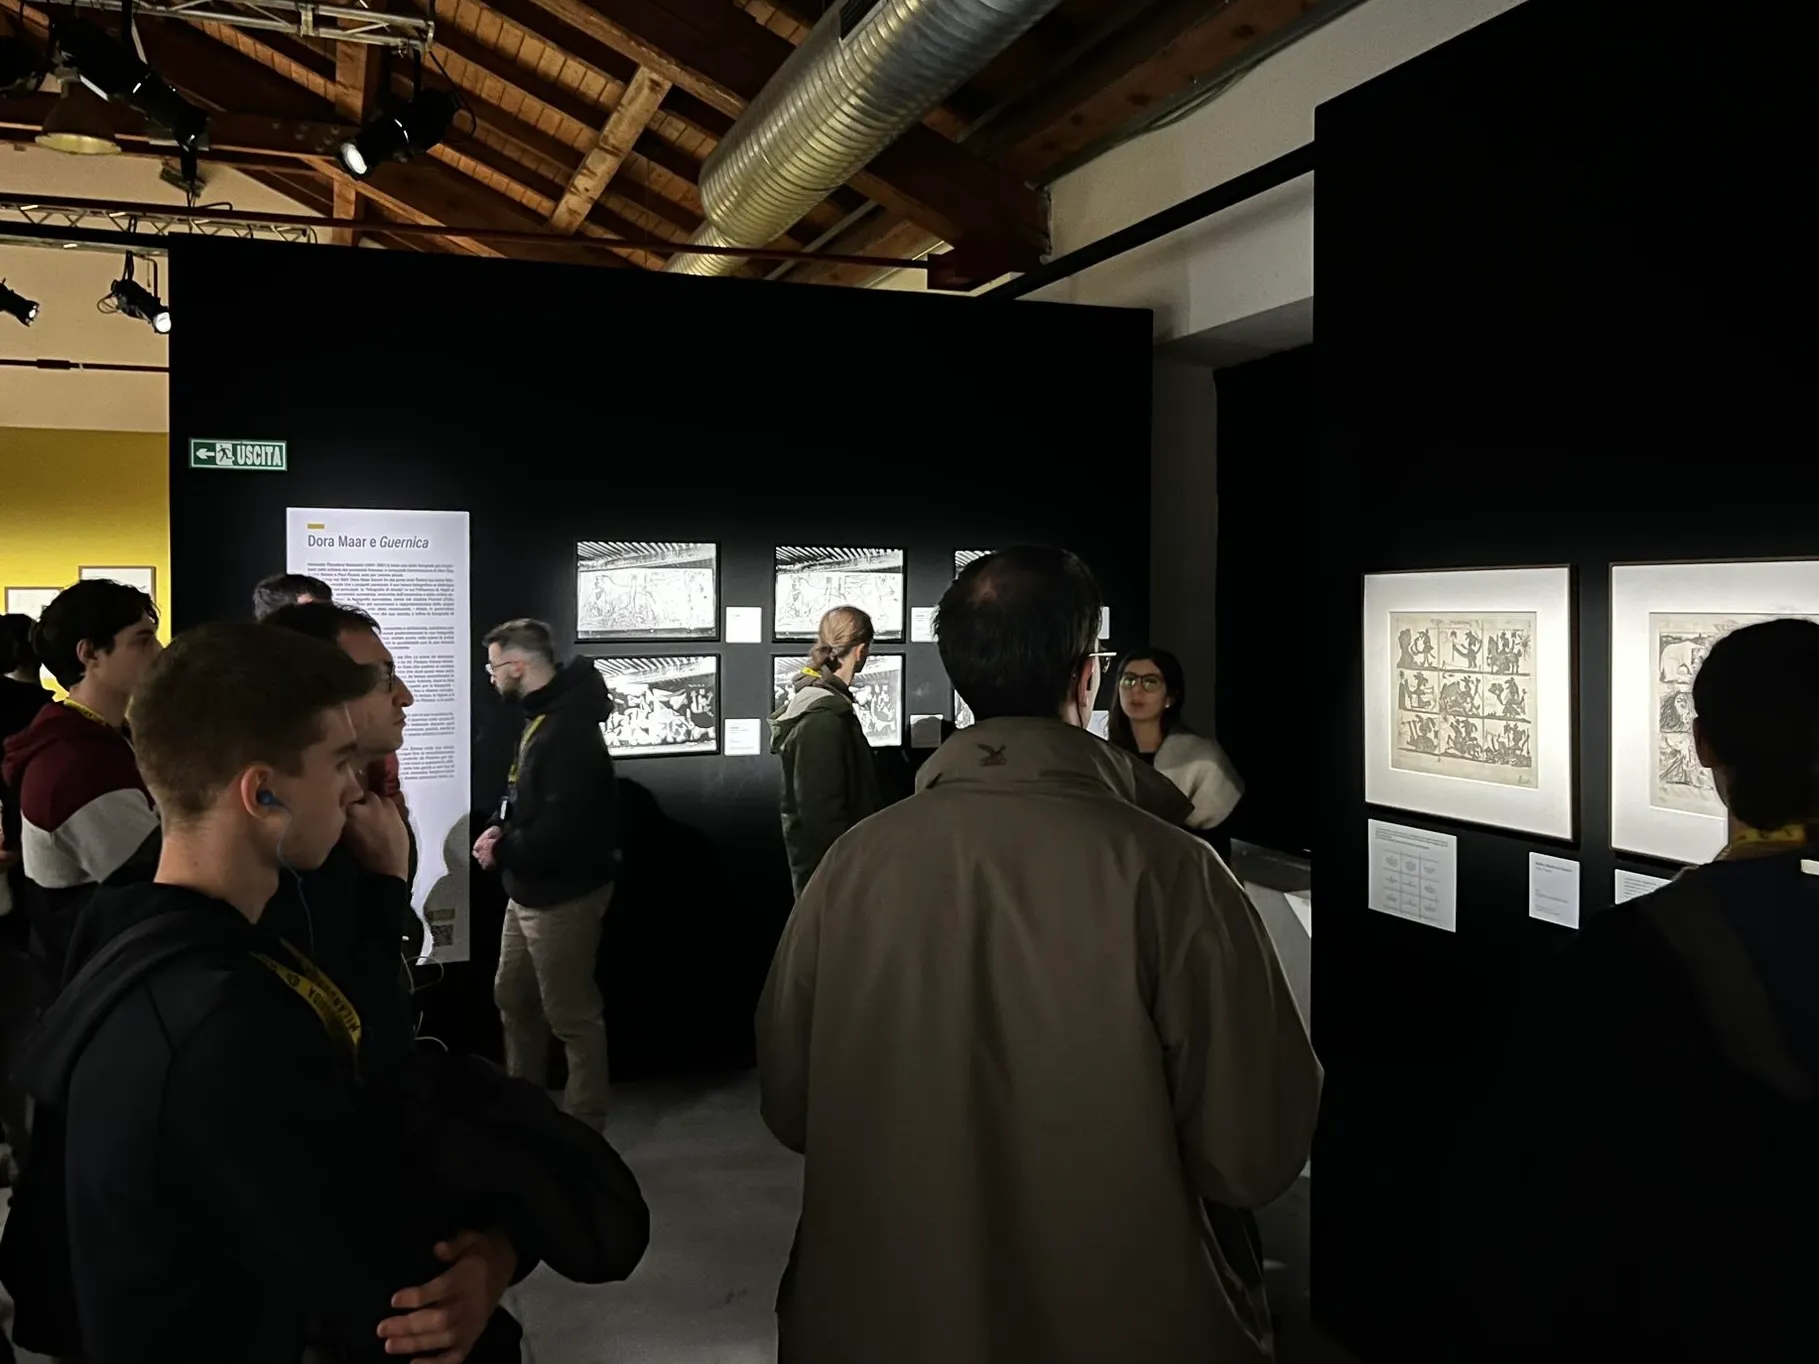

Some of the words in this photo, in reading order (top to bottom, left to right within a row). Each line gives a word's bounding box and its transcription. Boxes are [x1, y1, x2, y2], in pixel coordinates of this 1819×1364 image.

[237, 444, 281, 466] USCITA
[308, 534, 335, 547] Dora
[338, 535, 367, 548] Maar
[369, 538, 377, 548] e
[379, 535, 429, 549] Guernica
